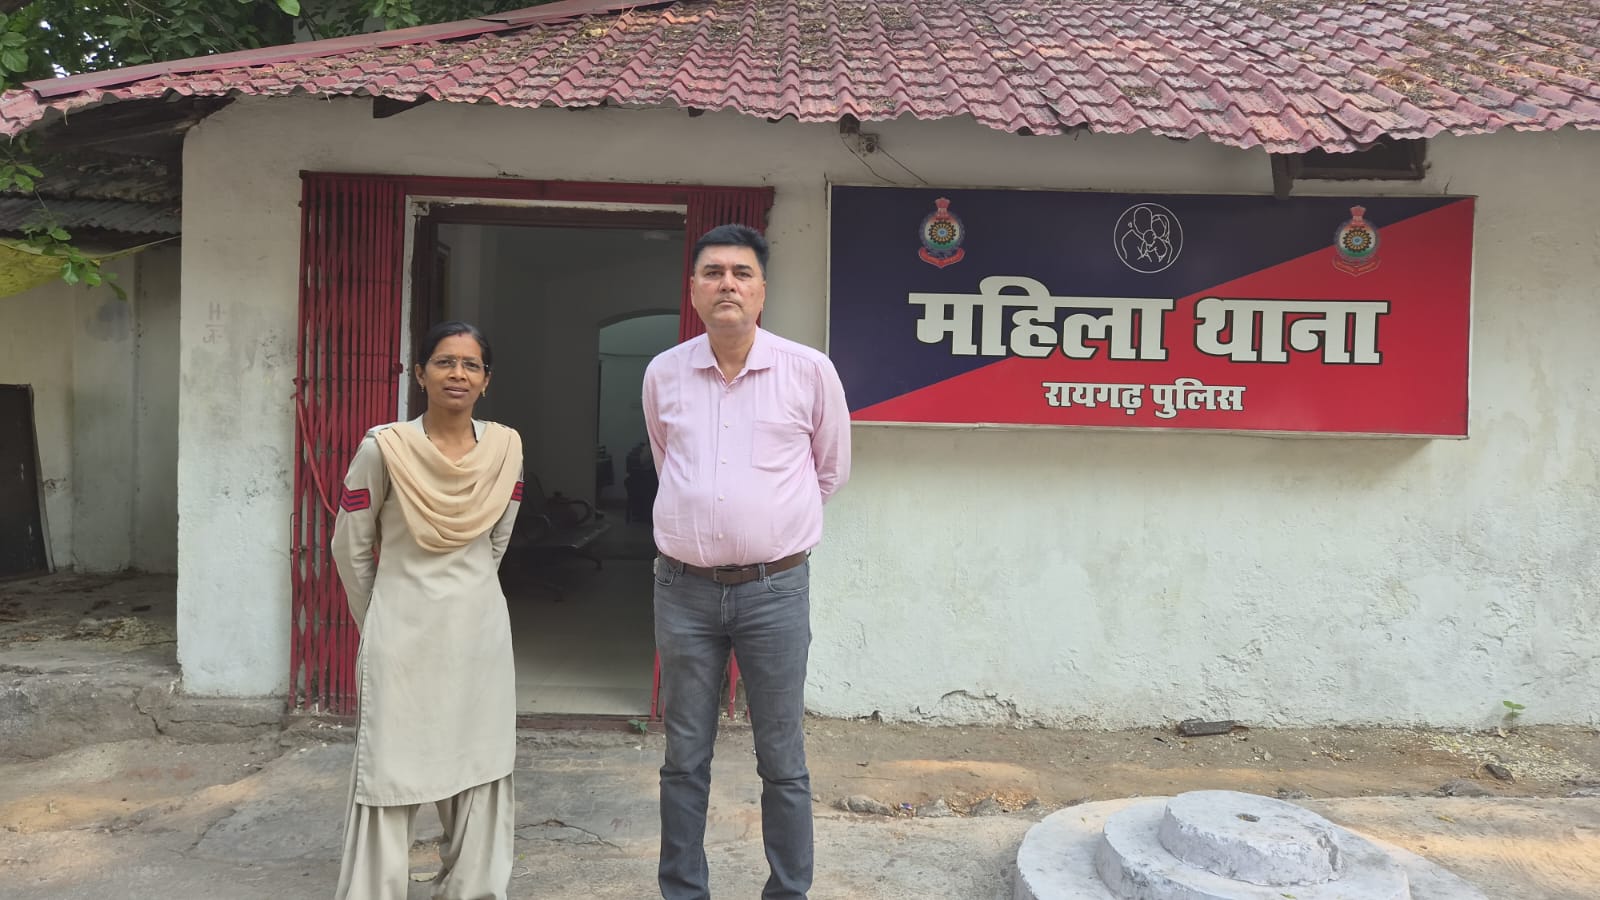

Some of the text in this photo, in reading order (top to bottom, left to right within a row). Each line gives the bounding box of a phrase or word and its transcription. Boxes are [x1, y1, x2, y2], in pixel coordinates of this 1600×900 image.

[908, 275, 1391, 364] महिला थाना
[1042, 377, 1247, 419] रायगढ़ पुलिस
